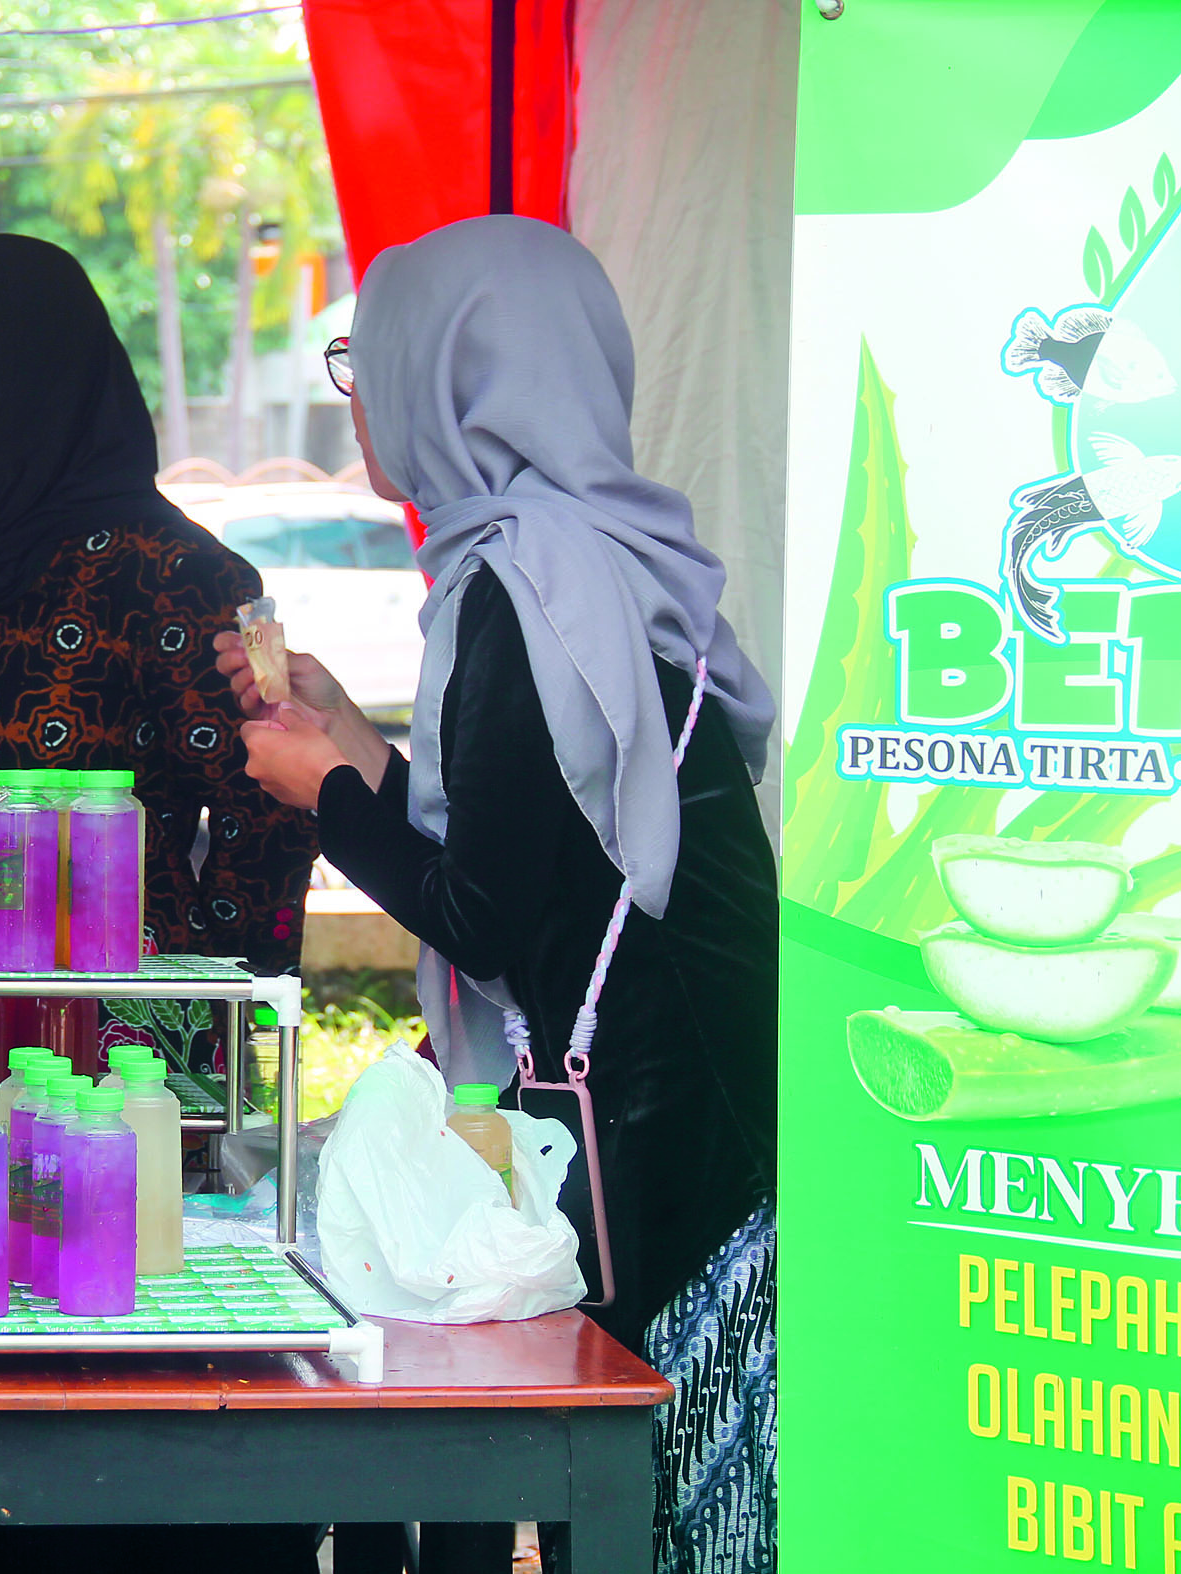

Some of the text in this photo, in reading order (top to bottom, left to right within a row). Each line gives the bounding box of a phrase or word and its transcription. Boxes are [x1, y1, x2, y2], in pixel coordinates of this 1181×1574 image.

[849, 735, 1166, 784] PESONA TIRTA
[959, 1253, 1181, 1357] PELEPAH
[968, 1363, 1181, 1468] OLAHAN
[1008, 1475, 1144, 1570] BIBIT
